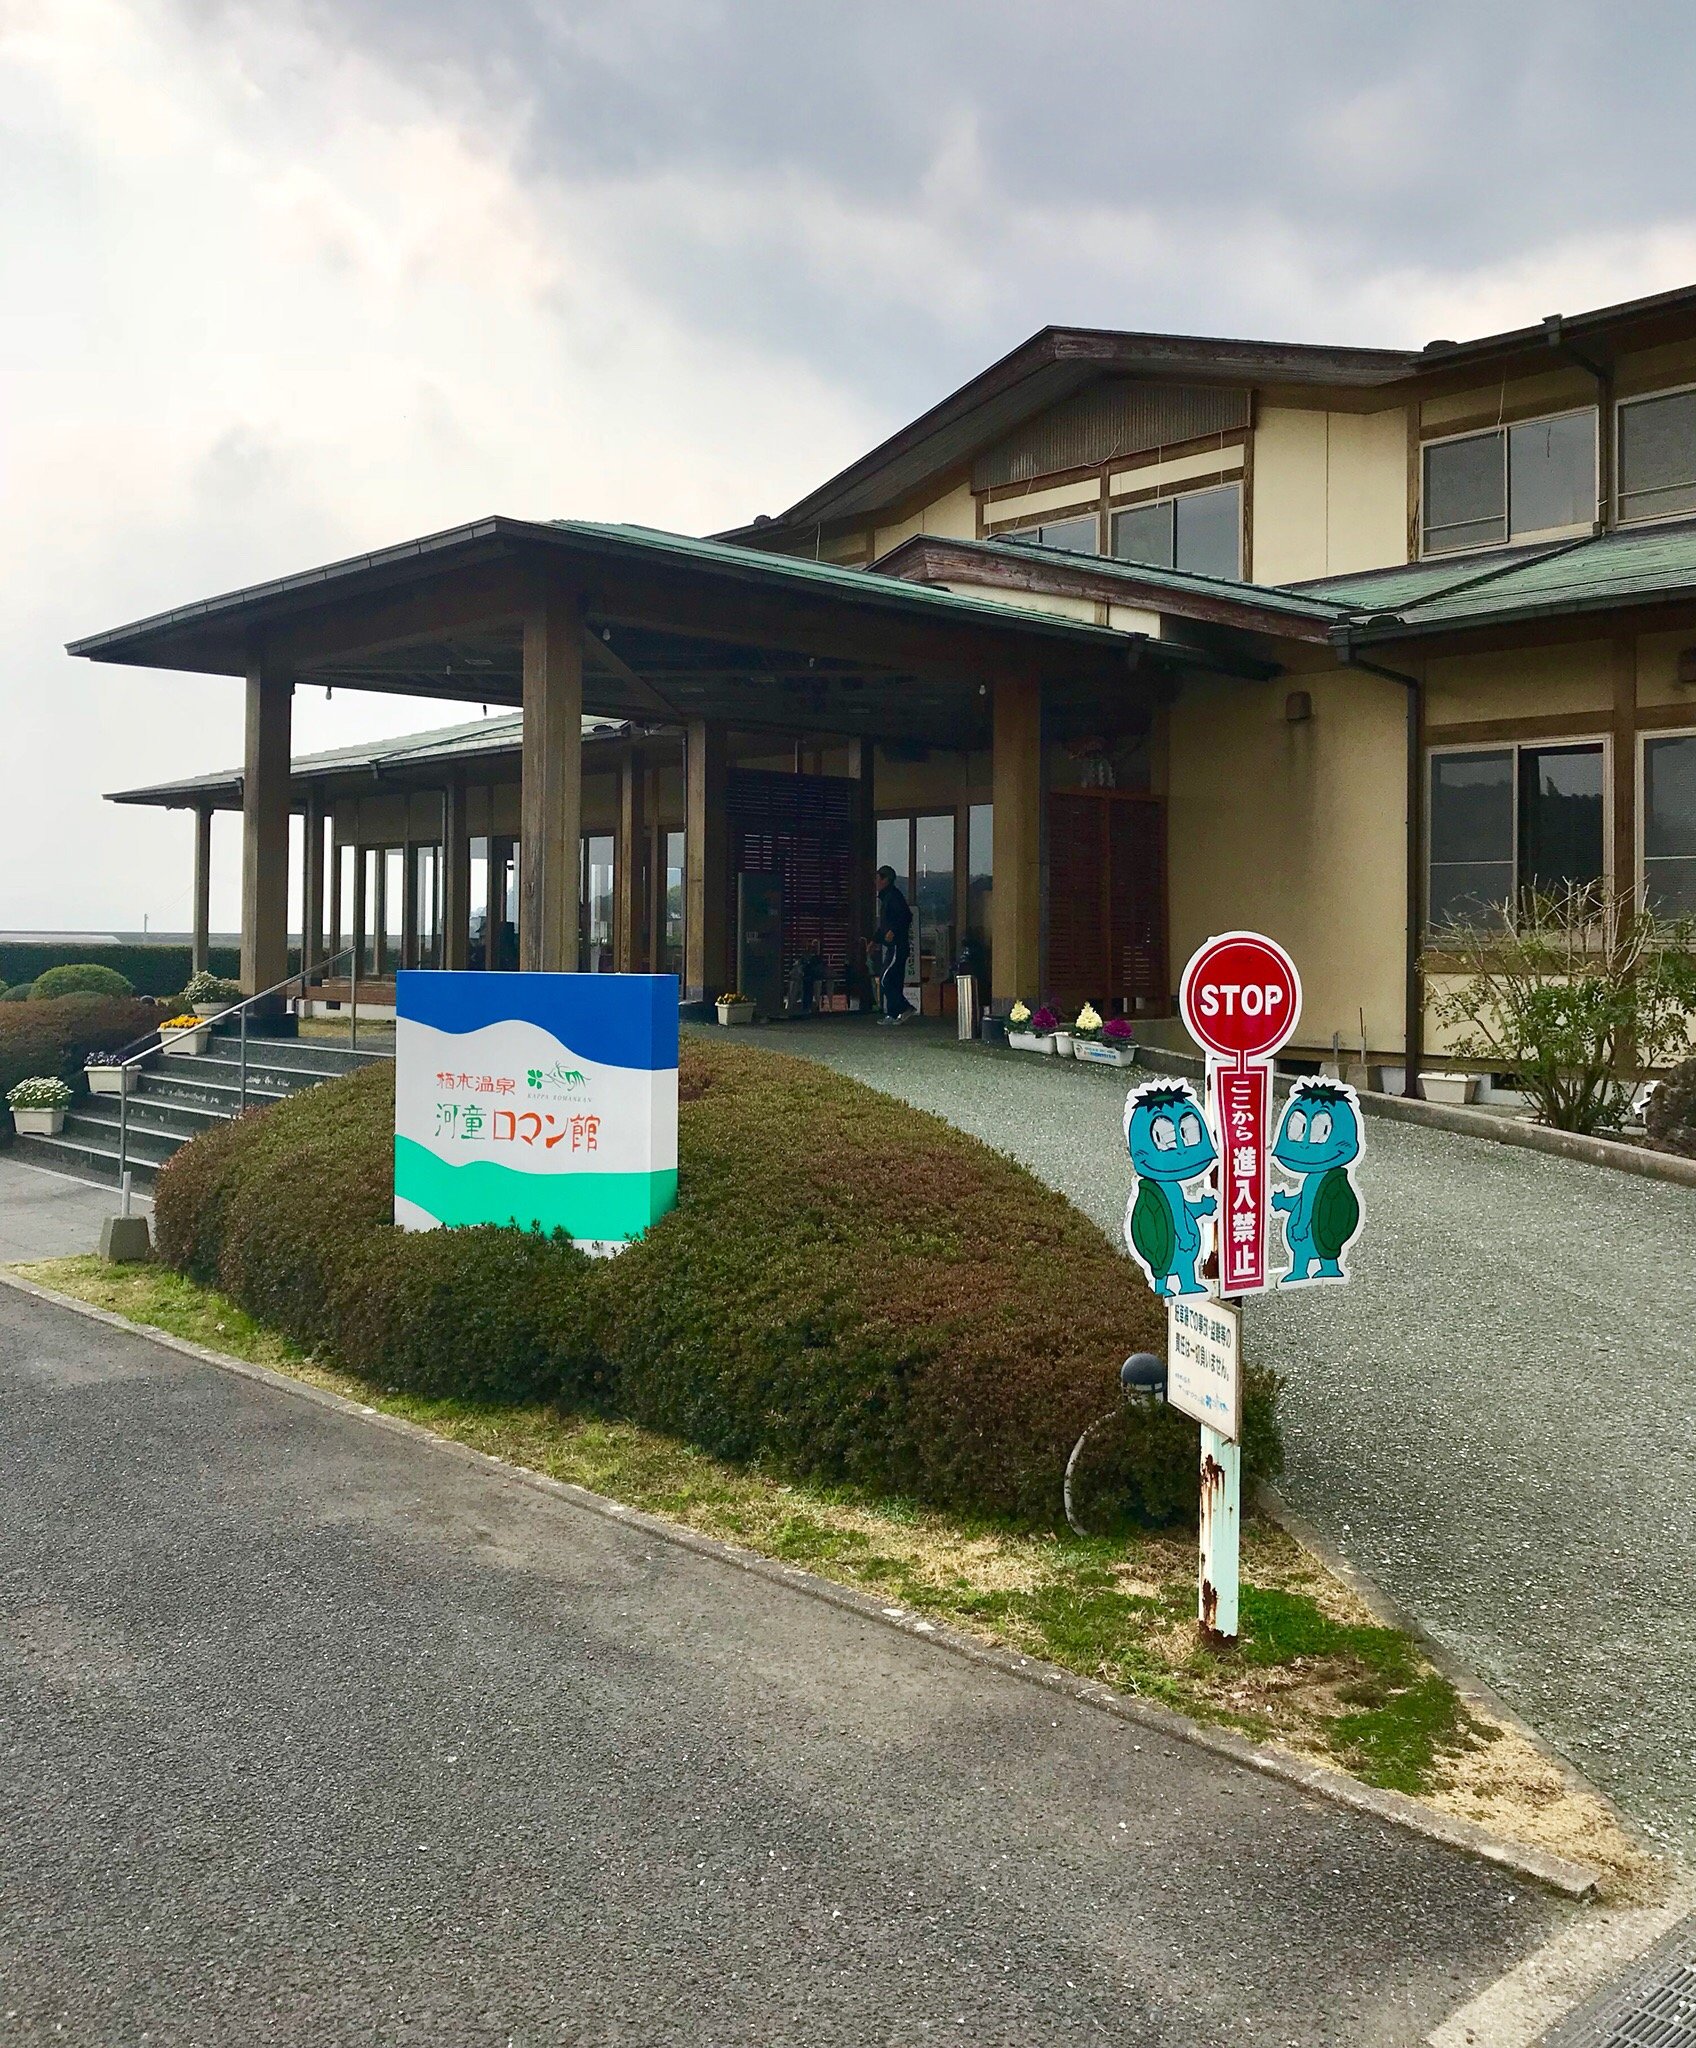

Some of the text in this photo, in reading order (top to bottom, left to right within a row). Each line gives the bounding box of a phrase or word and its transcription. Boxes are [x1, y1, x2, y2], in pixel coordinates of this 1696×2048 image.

[1200, 984, 1283, 1016] STOP
[435, 1103, 601, 1153] 河童ロマン館
[1230, 1080, 1257, 1276] ここから進入禁止
